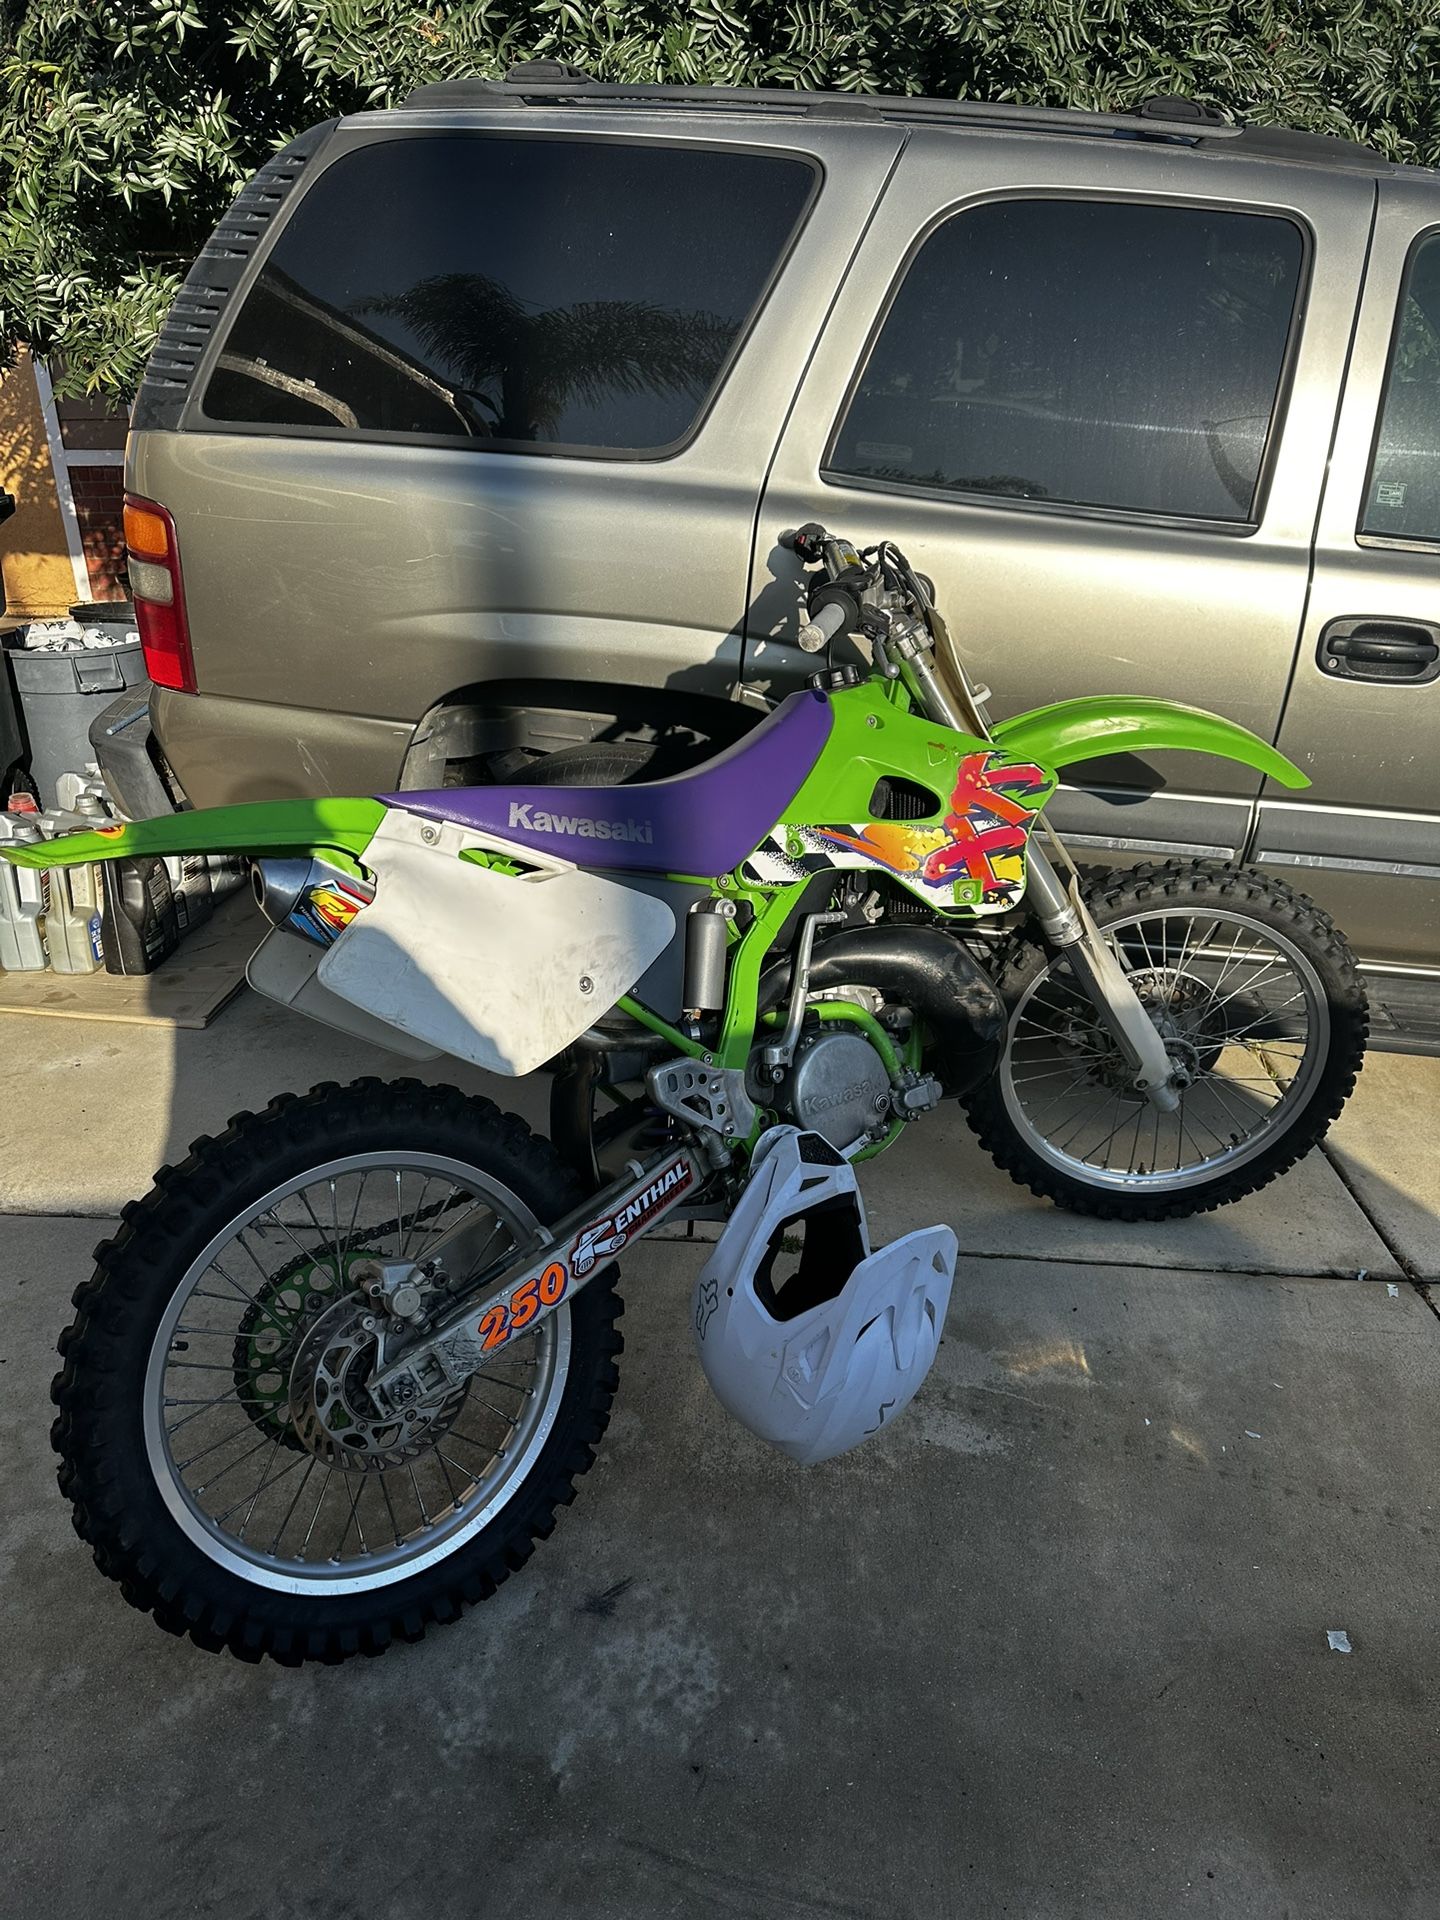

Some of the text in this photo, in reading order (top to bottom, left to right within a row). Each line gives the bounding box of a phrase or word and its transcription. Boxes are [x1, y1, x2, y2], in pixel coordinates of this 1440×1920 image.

[508, 802, 653, 844] Kawasaki
[803, 1076, 888, 1115] Kawasa
[477, 1261, 569, 1351] 250
